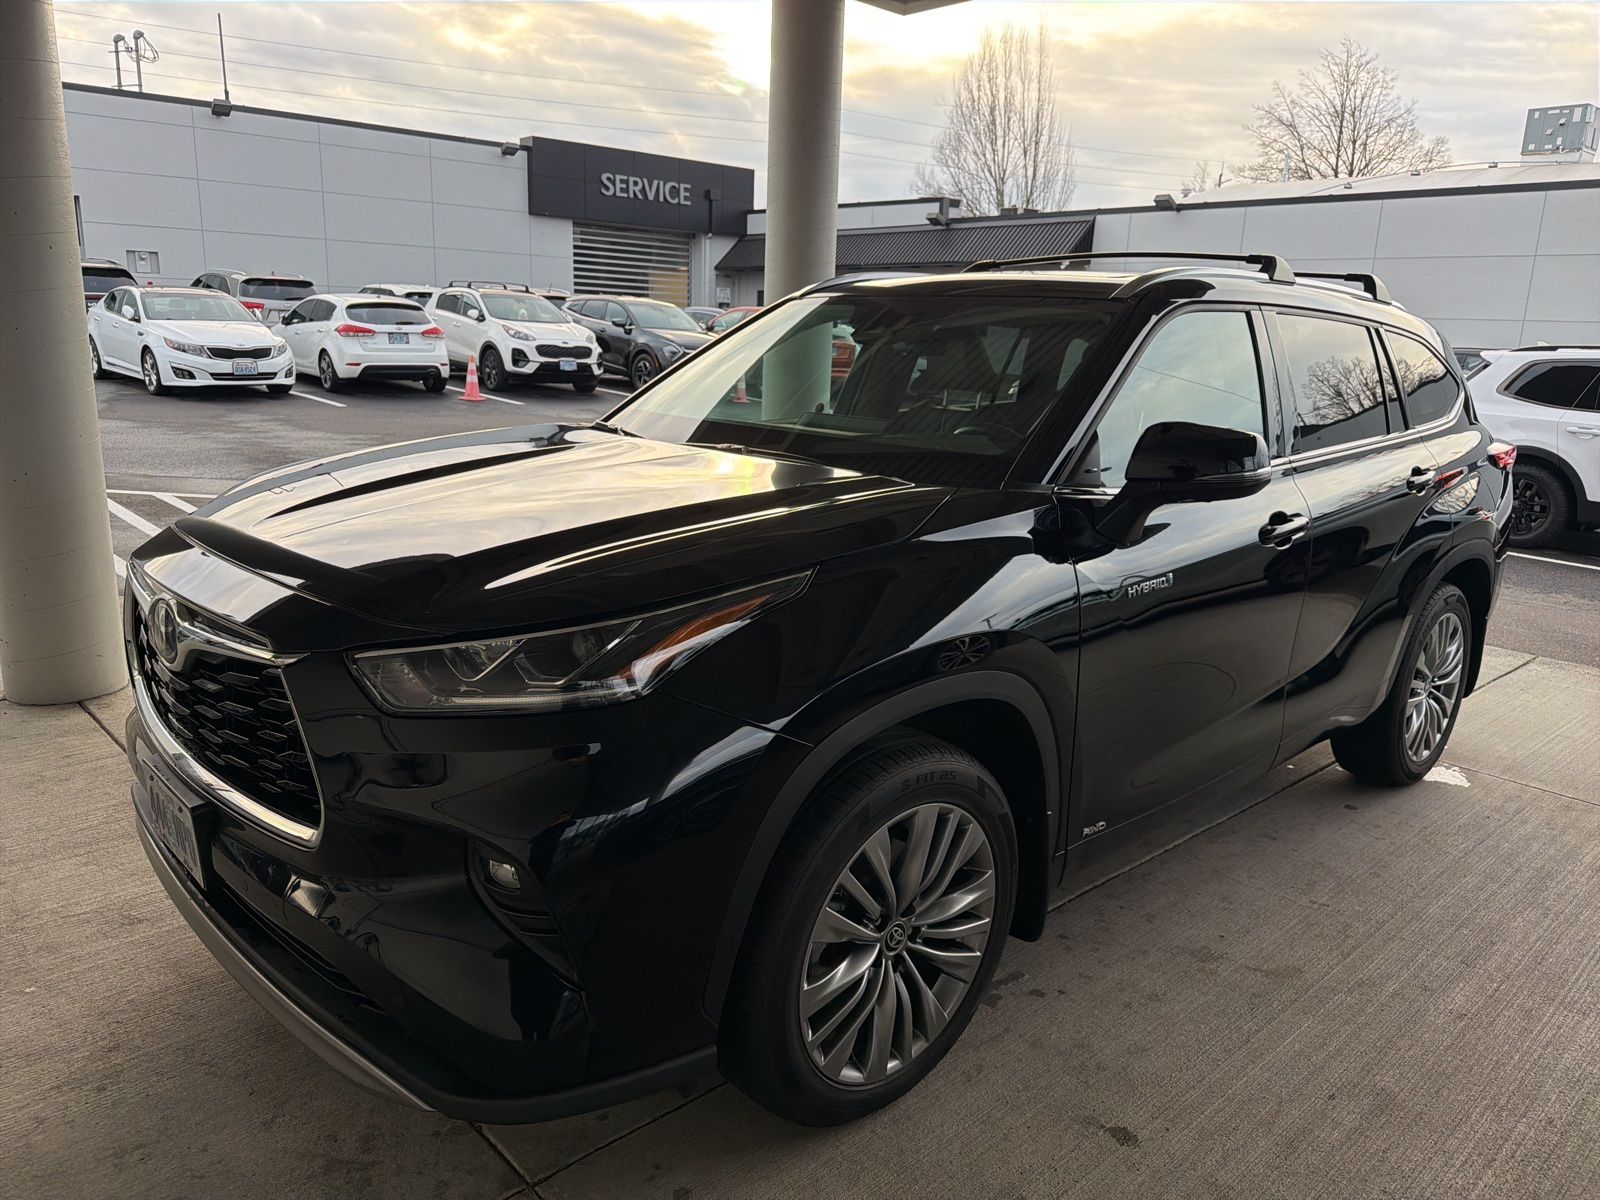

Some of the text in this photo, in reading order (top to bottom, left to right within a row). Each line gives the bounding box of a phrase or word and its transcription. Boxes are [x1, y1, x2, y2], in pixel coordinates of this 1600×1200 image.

[601, 173, 691, 205] SERVICE
[1128, 577, 1168, 598] HYBRID
[916, 771, 938, 785] FIT
